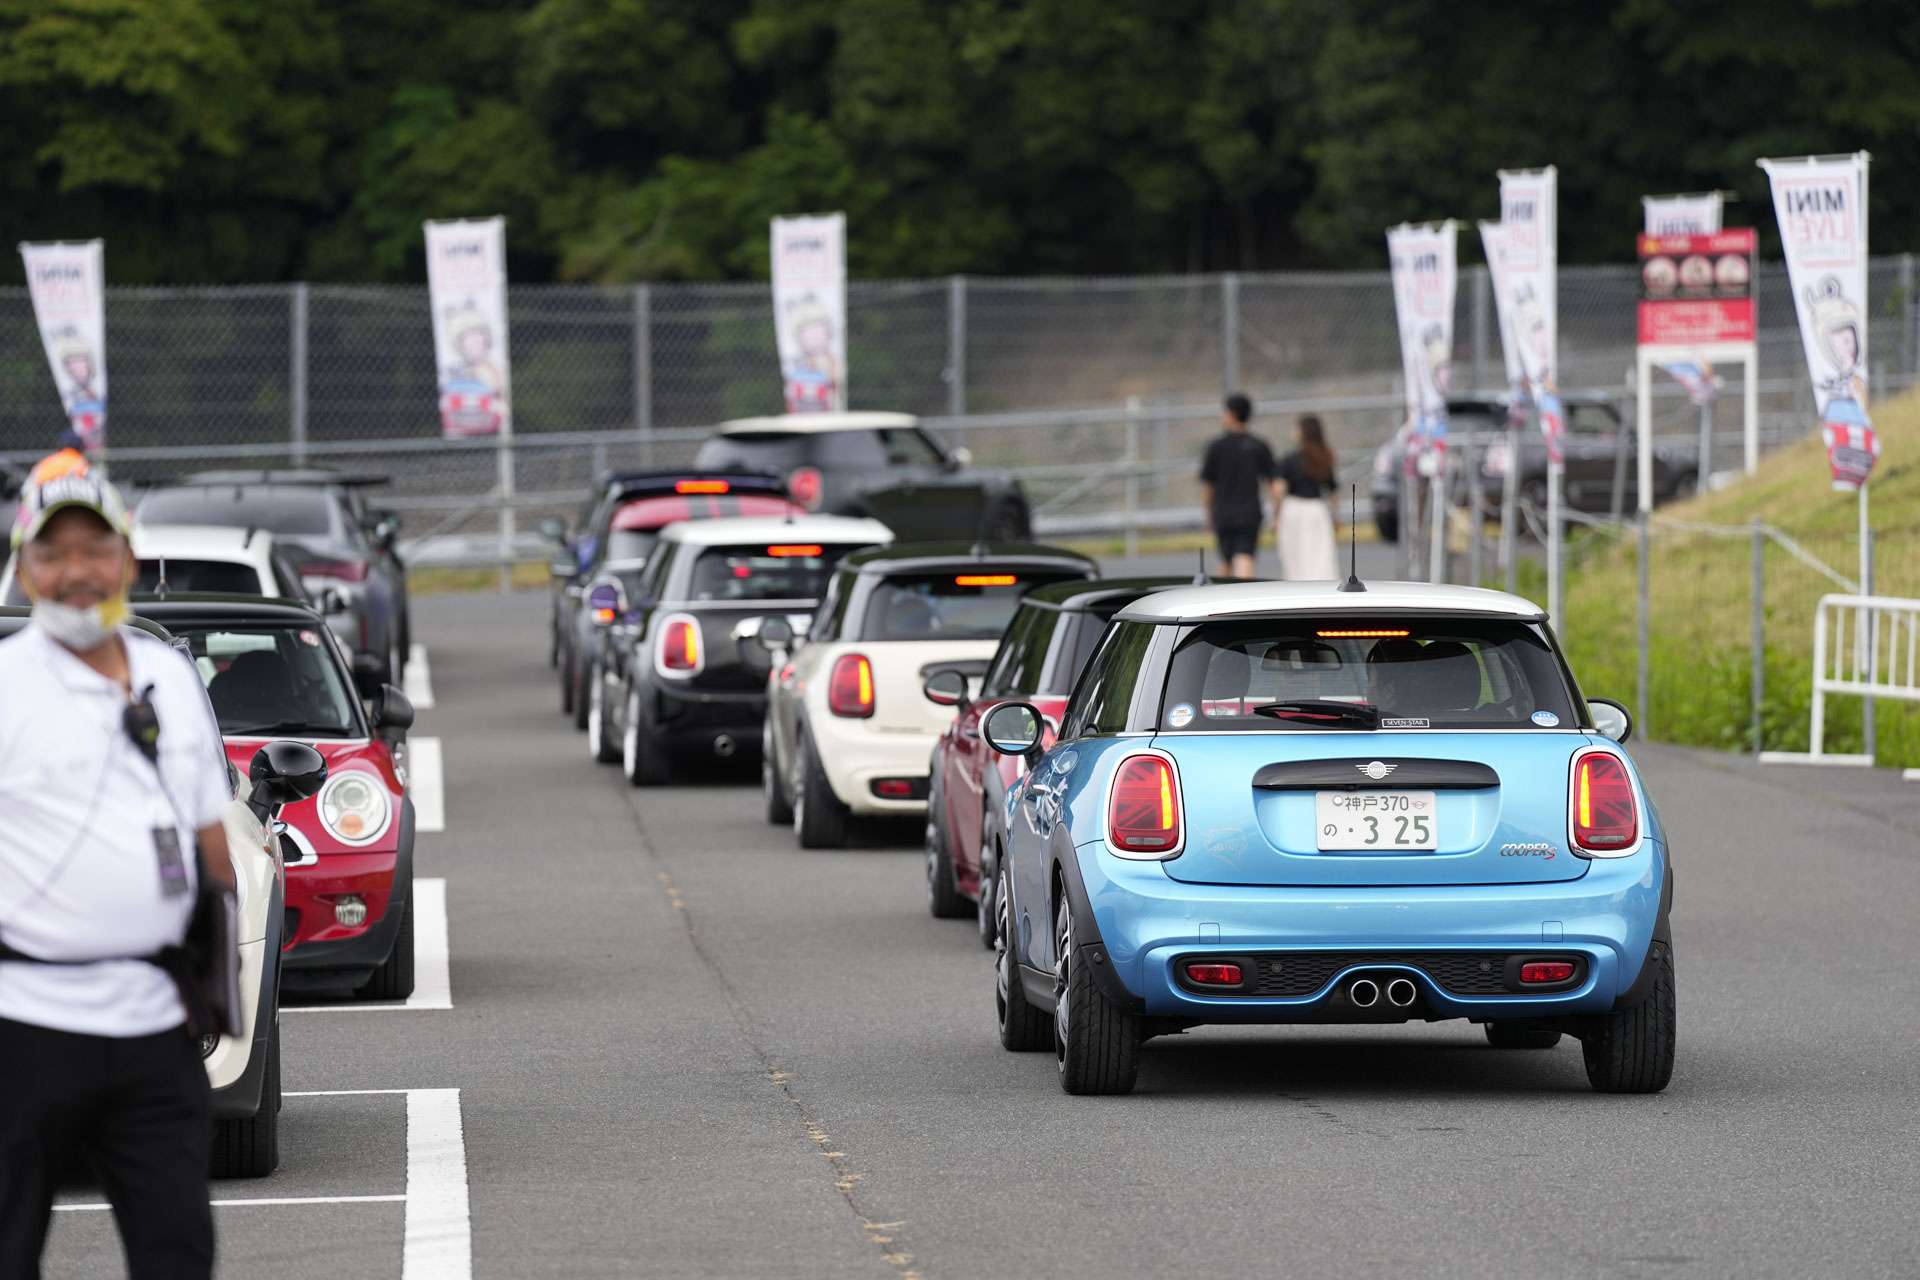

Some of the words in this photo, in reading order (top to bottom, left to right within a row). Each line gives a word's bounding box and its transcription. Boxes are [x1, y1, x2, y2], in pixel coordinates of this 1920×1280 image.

[1323, 823, 1338, 837] の
[1500, 843, 1548, 857] COOPER
[1543, 846, 1557, 860] S
